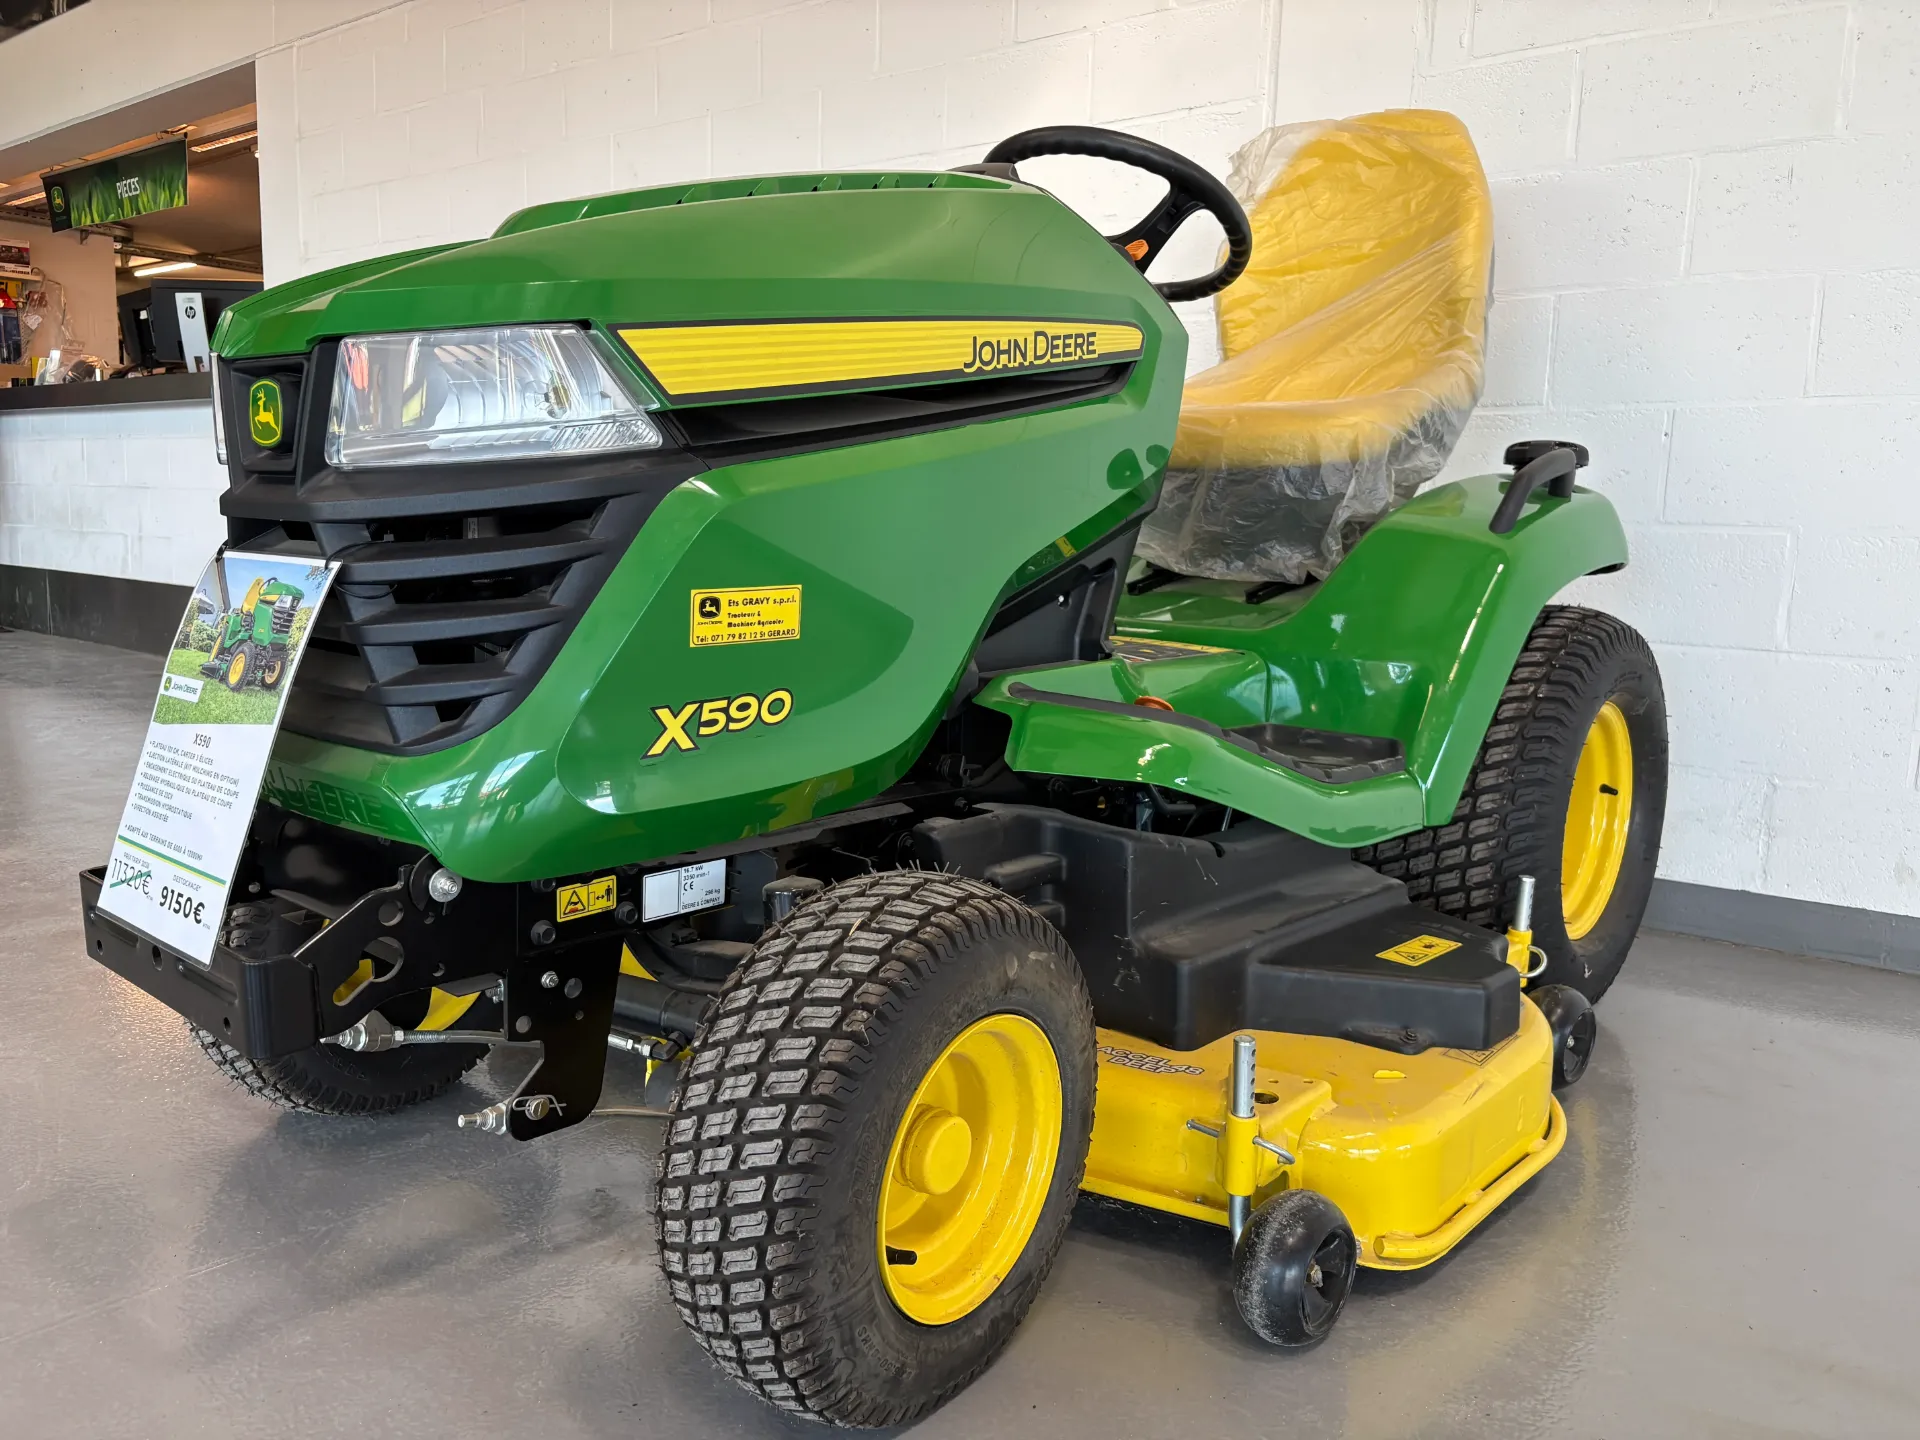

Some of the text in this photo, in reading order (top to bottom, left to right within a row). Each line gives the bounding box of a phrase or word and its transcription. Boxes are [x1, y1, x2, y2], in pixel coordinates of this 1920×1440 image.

[116, 177, 140, 199] PIÈCES
[963, 330, 1097, 369] JOHN DEERE
[728, 595, 796, 607] Ets GRAVY s.p.r.l.
[727, 611, 755, 619] Tracteurs
[727, 618, 784, 628] Machines Agricoles
[727, 633, 736, 641] 79
[738, 632, 747, 640] 82
[749, 631, 758, 639] 12
[768, 628, 796, 638] GERARD
[183, 684, 198, 695] DEERE
[640, 687, 794, 760] X590
[152, 740, 167, 752] PLATEAU
[180, 749, 196, 761] CARTER
[193, 733, 211, 748] X590
[192, 765, 213, 780] MULCHING
[220, 774, 240, 787] OPTION)
[197, 779, 217, 792] PLATEAU
[223, 787, 240, 799] COUPE
[191, 789, 210, 802] PLATEAU
[217, 797, 233, 810] COUPE
[112, 858, 153, 896] 11320€
[159, 886, 205, 924] 9150€
[682, 901, 696, 910] DEERE
[700, 896, 720, 906] COMPANY
[1098, 1046, 1171, 1067] ACCEL
[1107, 1056, 1177, 1074] DEEP
